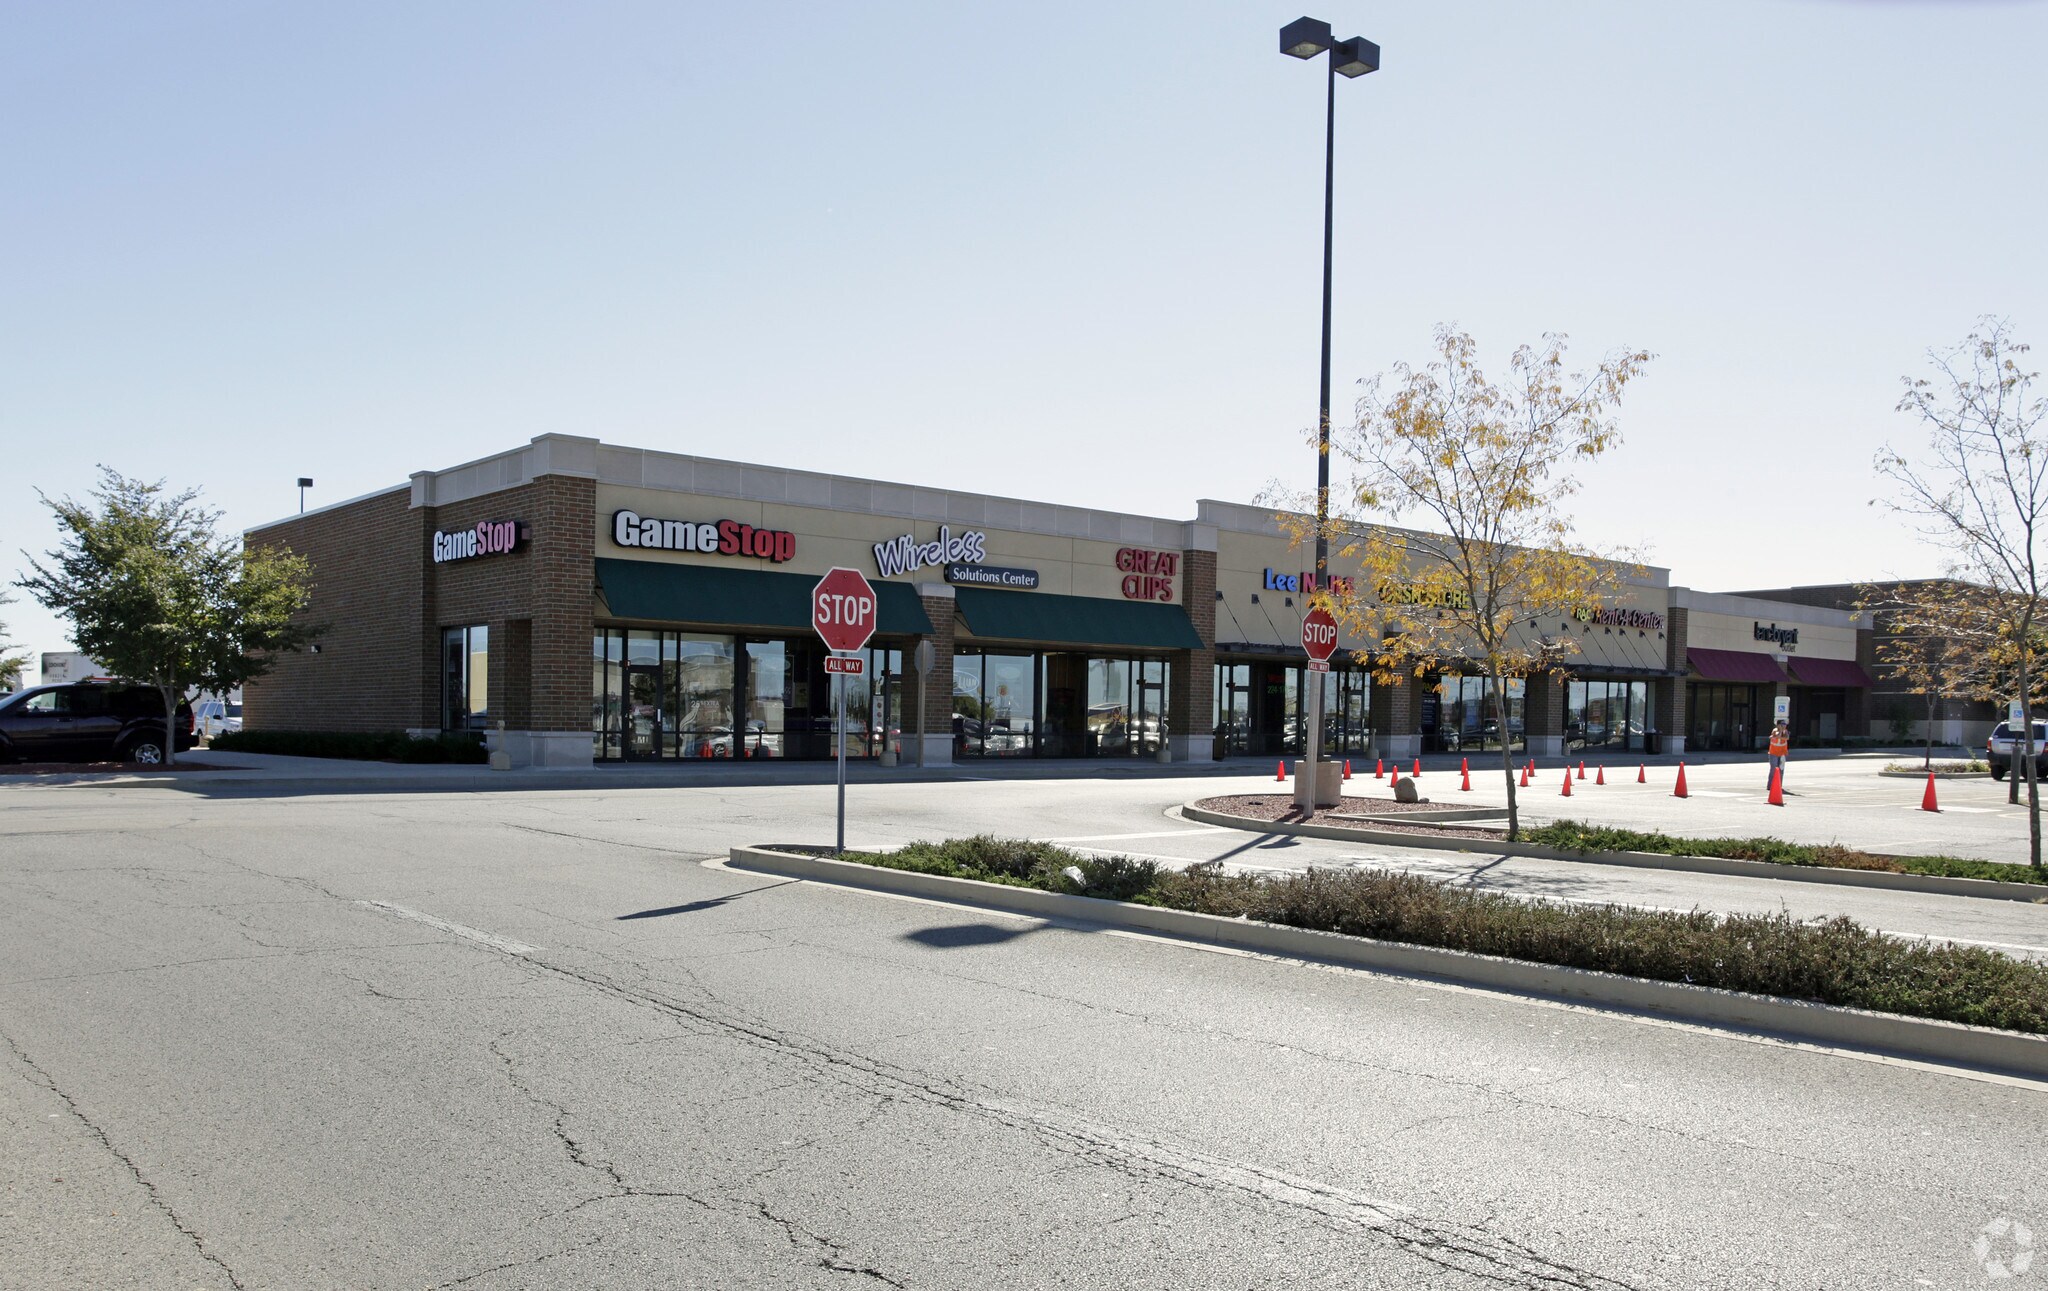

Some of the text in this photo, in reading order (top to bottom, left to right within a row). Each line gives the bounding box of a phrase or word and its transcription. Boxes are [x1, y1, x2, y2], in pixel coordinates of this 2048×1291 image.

[433, 521, 516, 563] GameStop
[612, 509, 797, 563] GameStop
[873, 524, 986, 578] Wireless
[1116, 548, 1180, 577] GREAT
[953, 567, 1035, 587] Solutions Center
[1122, 574, 1174, 602] CLIPS
[1263, 568, 1297, 592] Lee
[818, 593, 872, 626] STOP
[1304, 622, 1336, 645] STOP
[828, 660, 861, 672] ALL WAY
[1310, 662, 1318, 671] ALL
